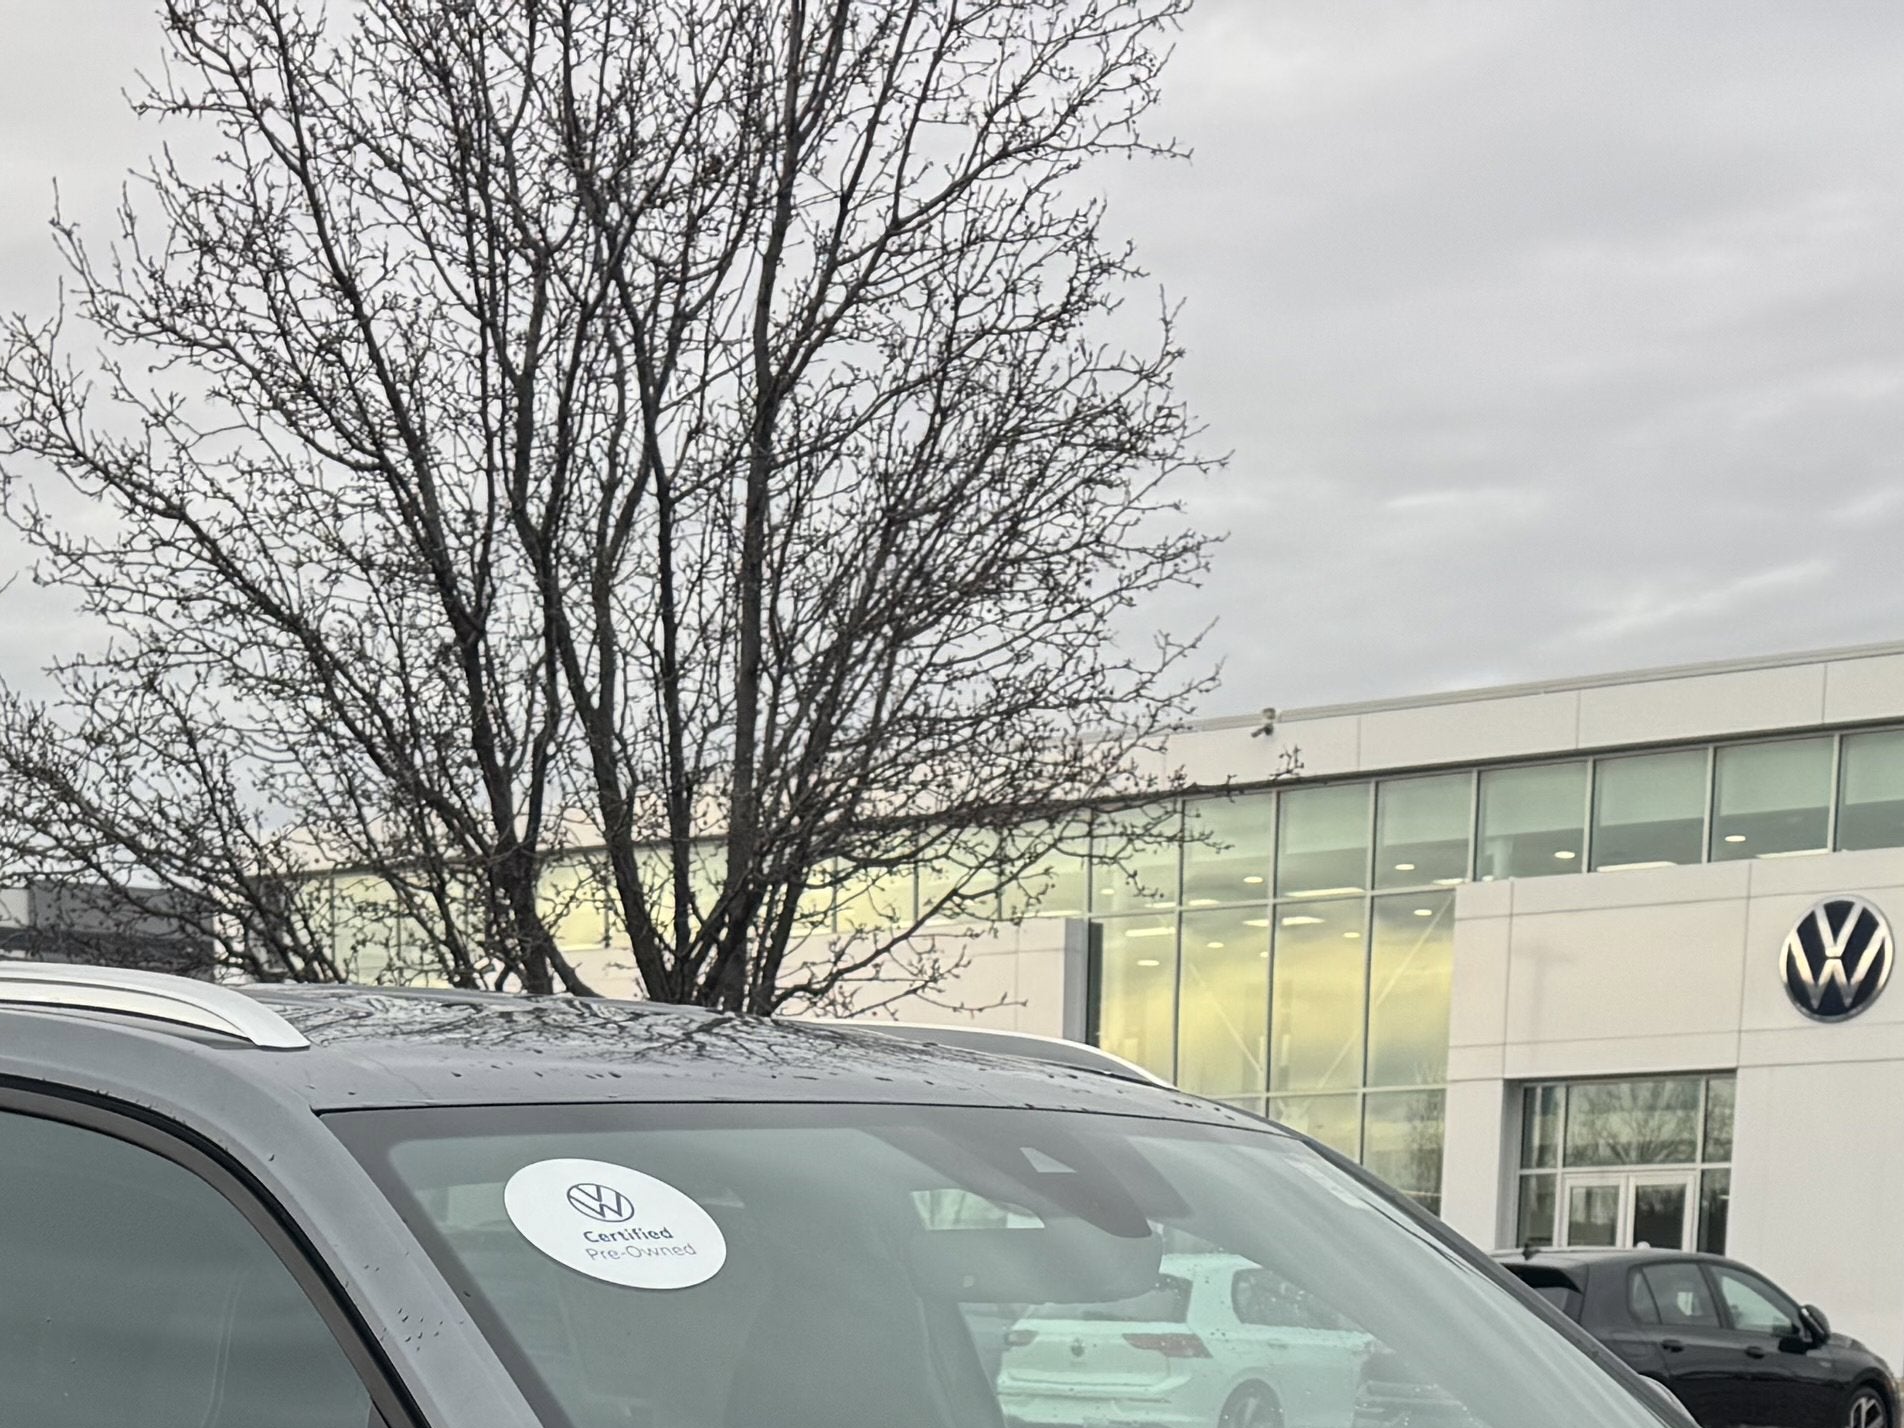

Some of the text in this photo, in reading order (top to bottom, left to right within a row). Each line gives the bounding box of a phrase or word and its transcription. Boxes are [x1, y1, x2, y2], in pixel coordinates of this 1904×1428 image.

[1779, 893, 1895, 1024] VW
[566, 1183, 635, 1223] VW
[583, 1227, 674, 1243] Certified
[585, 1243, 697, 1260] Pre-Owned
